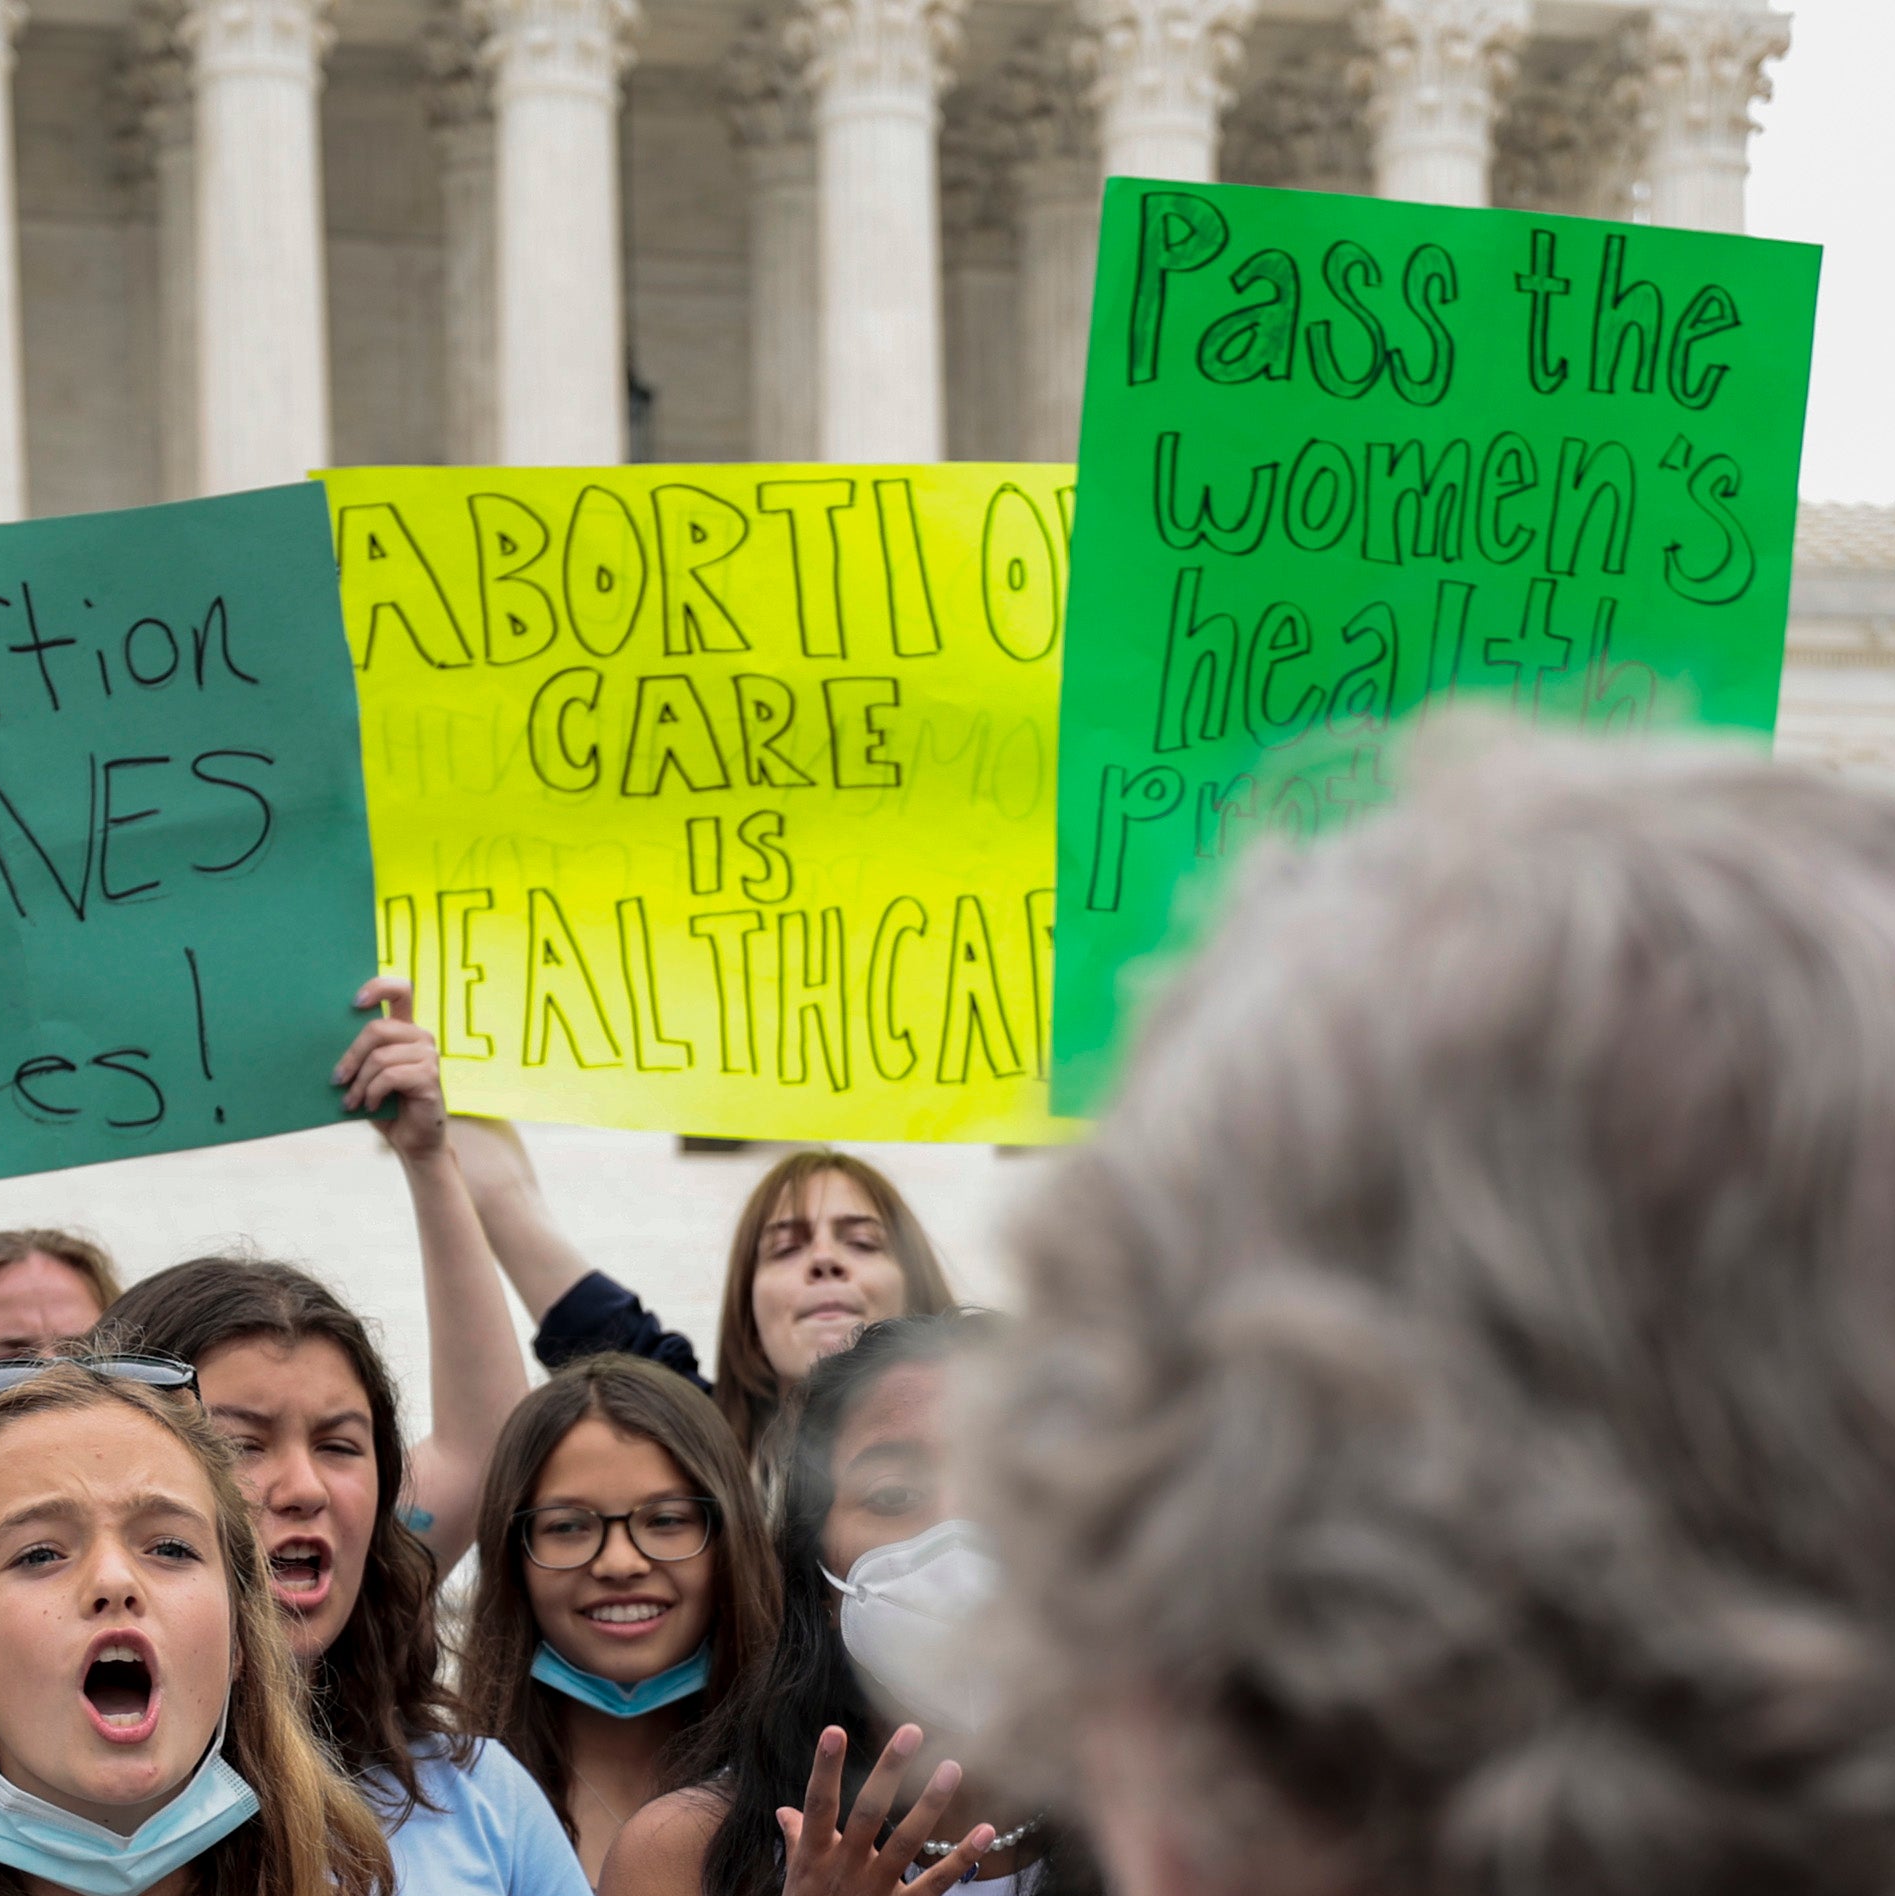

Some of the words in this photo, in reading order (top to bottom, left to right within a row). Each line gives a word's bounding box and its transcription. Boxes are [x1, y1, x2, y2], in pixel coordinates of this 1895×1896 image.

[1127, 192, 1458, 407] Pass
[1514, 229, 1743, 411] the
[336, 477, 1077, 671] ABORTIO
[1154, 430, 1756, 606] women's
[528, 666, 901, 797] CARE
[1154, 565, 1658, 754] health
[685, 810, 794, 905] IS
